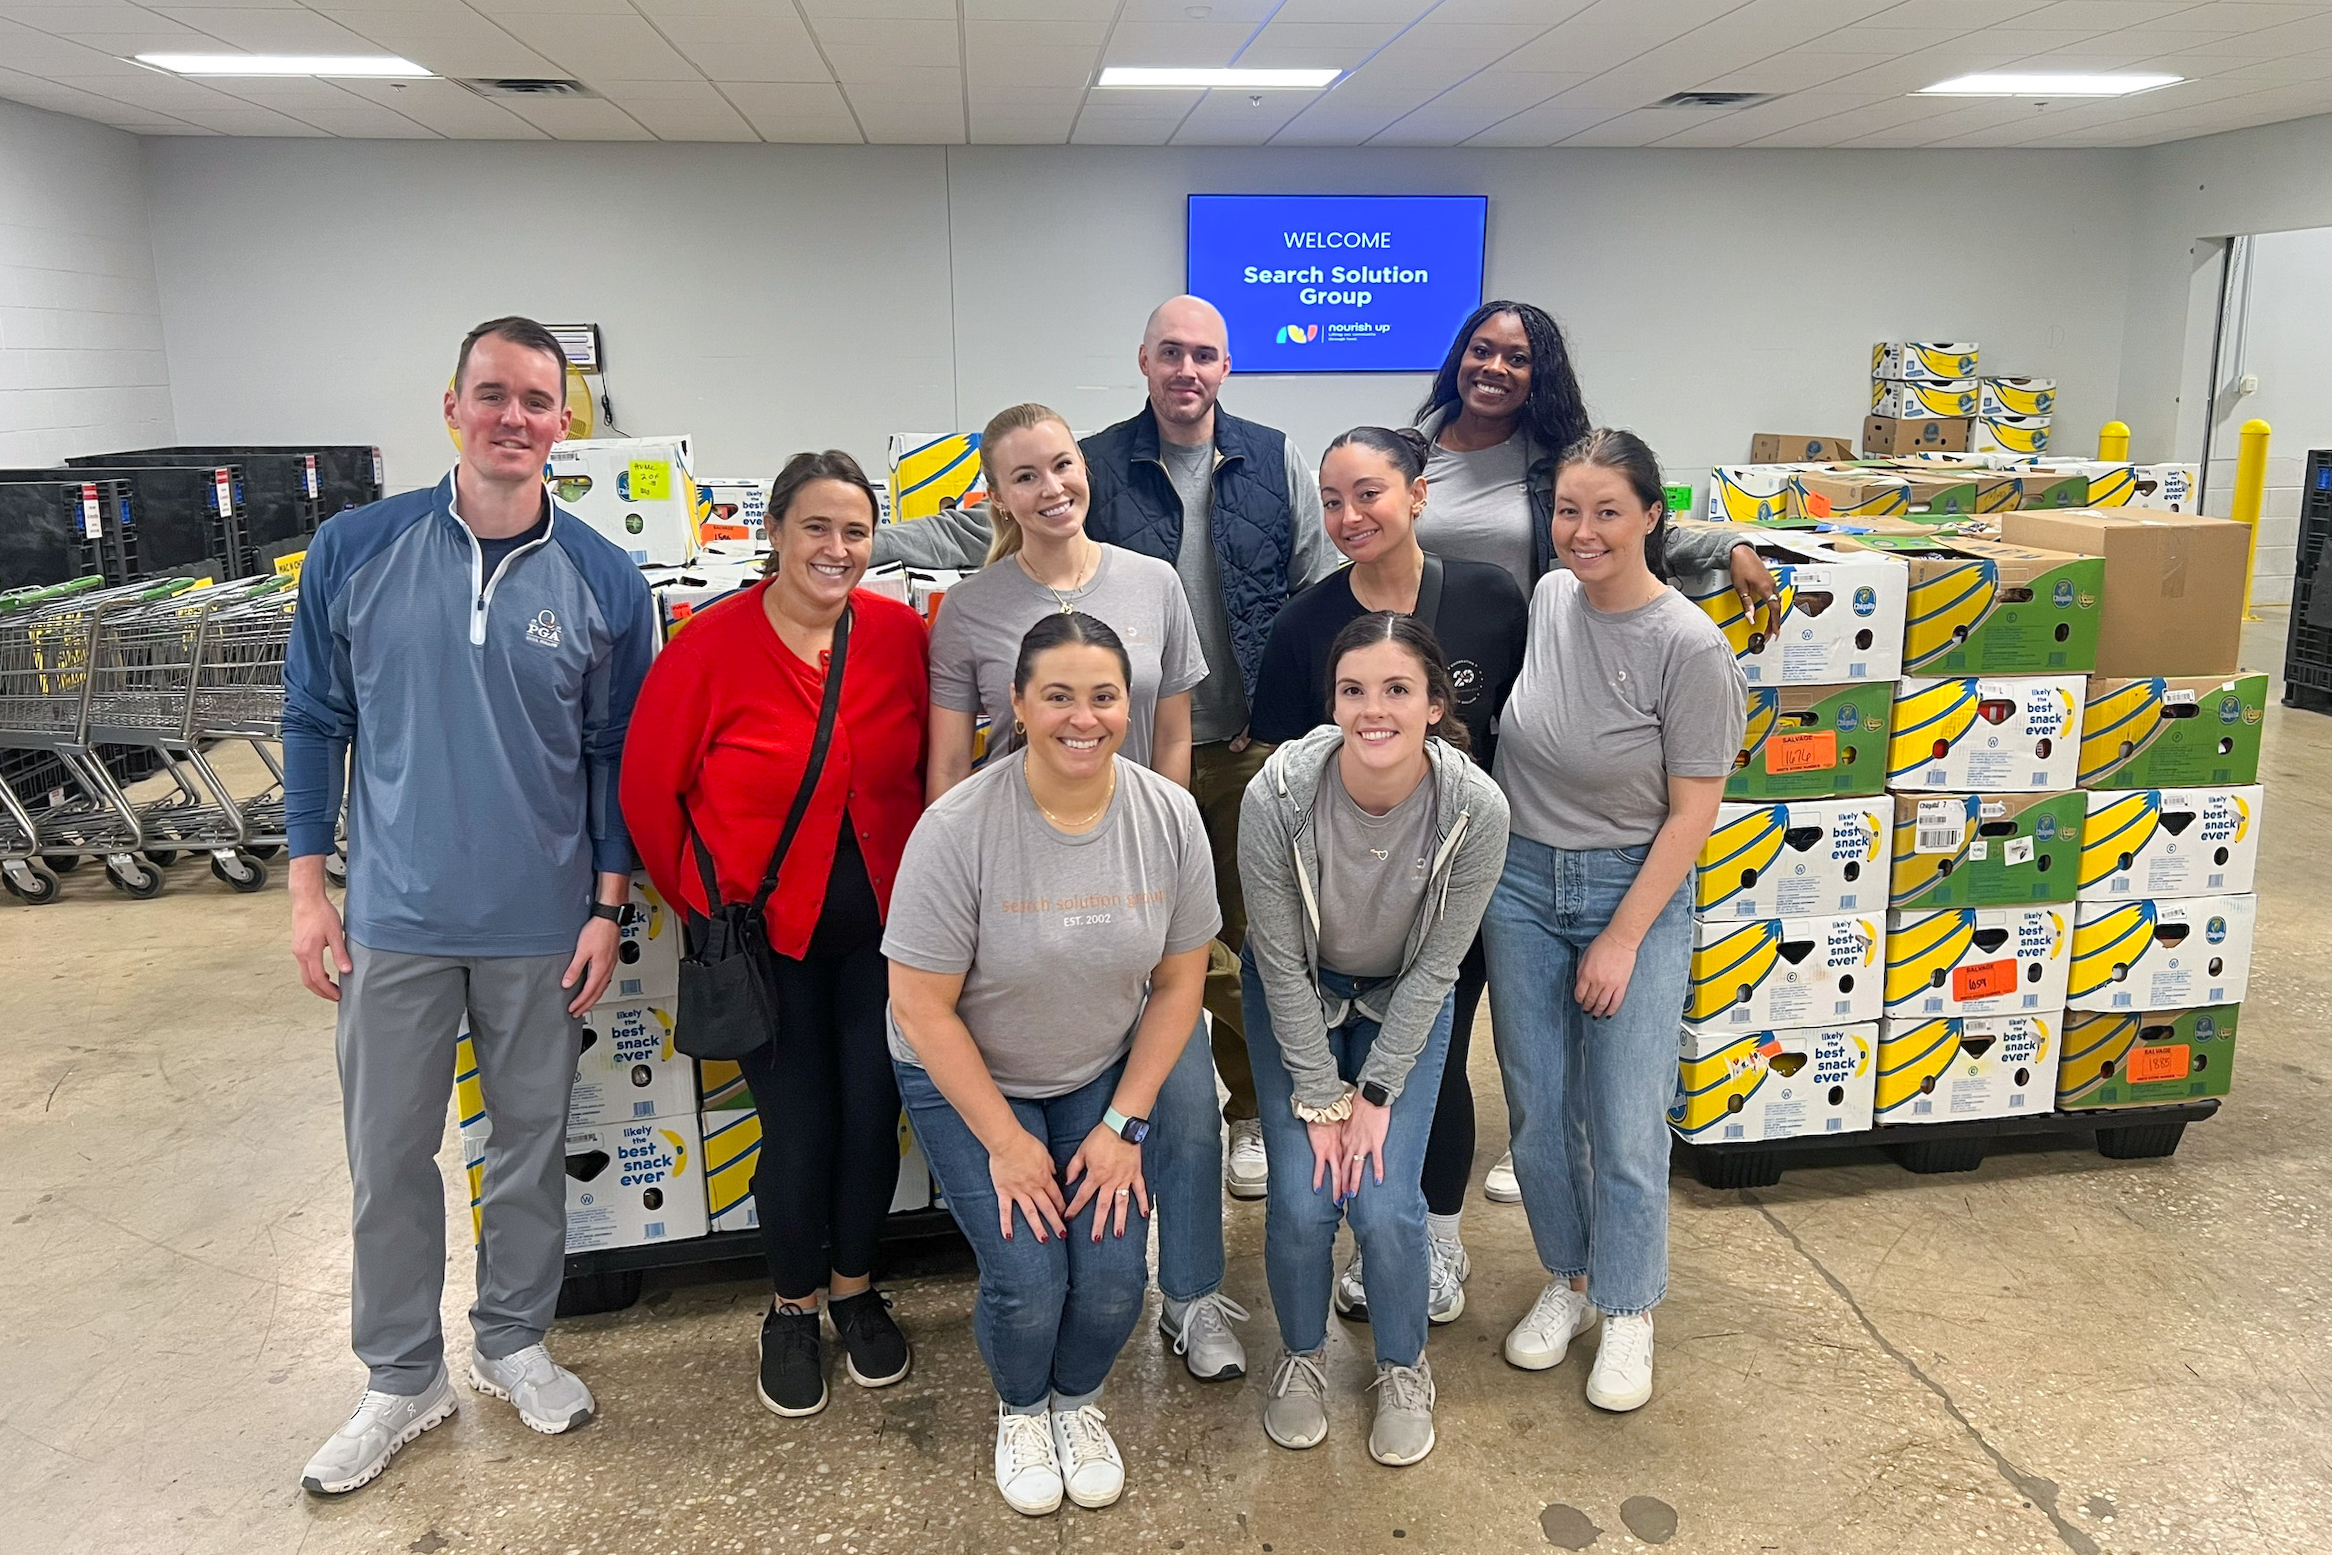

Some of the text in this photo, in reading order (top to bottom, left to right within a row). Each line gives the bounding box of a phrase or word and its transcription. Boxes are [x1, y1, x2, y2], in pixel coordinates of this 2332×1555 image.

[1284, 232, 1391, 248] WELCOME
[1244, 266, 1428, 283] Search Solution
[1300, 288, 1372, 307] Group
[1328, 322, 1390, 333] nourish up
[527, 624, 560, 642] PGA
[2028, 702, 2053, 712] best
[2030, 714, 2062, 724] snack
[2026, 726, 2056, 735] ever
[2203, 809, 2228, 819] best
[2205, 819, 2236, 830] snack
[1833, 827, 1860, 837] best
[2201, 831, 2230, 840] ever
[1835, 836, 1869, 848] snack
[1831, 849, 1862, 859] ever
[1003, 896, 1050, 913] search
[1056, 894, 1121, 910] solution
[1064, 914, 1111, 926] EST. 2002
[2019, 926, 2043, 936] best
[1828, 935, 1854, 945] best
[2021, 935, 2052, 946] snack
[1831, 944, 1863, 955] snack
[2017, 948, 2046, 957] ever
[1827, 956, 1858, 967] ever
[616, 1009, 642, 1019] likely
[612, 1024, 646, 1038] best
[1822, 1032, 1844, 1040] likely
[2003, 1031, 2028, 1041] best
[617, 1035, 660, 1050] snack
[2005, 1041, 2036, 1051] snack
[613, 1050, 653, 1062] ever
[1816, 1046, 1845, 1059] best
[2001, 1052, 2029, 1062] ever
[1818, 1058, 1856, 1070] snack
[1814, 1072, 1849, 1083] ever
[623, 1125, 652, 1137] likely
[618, 1142, 657, 1159] best
[624, 1154, 673, 1172] snack
[620, 1171, 665, 1186] ever
